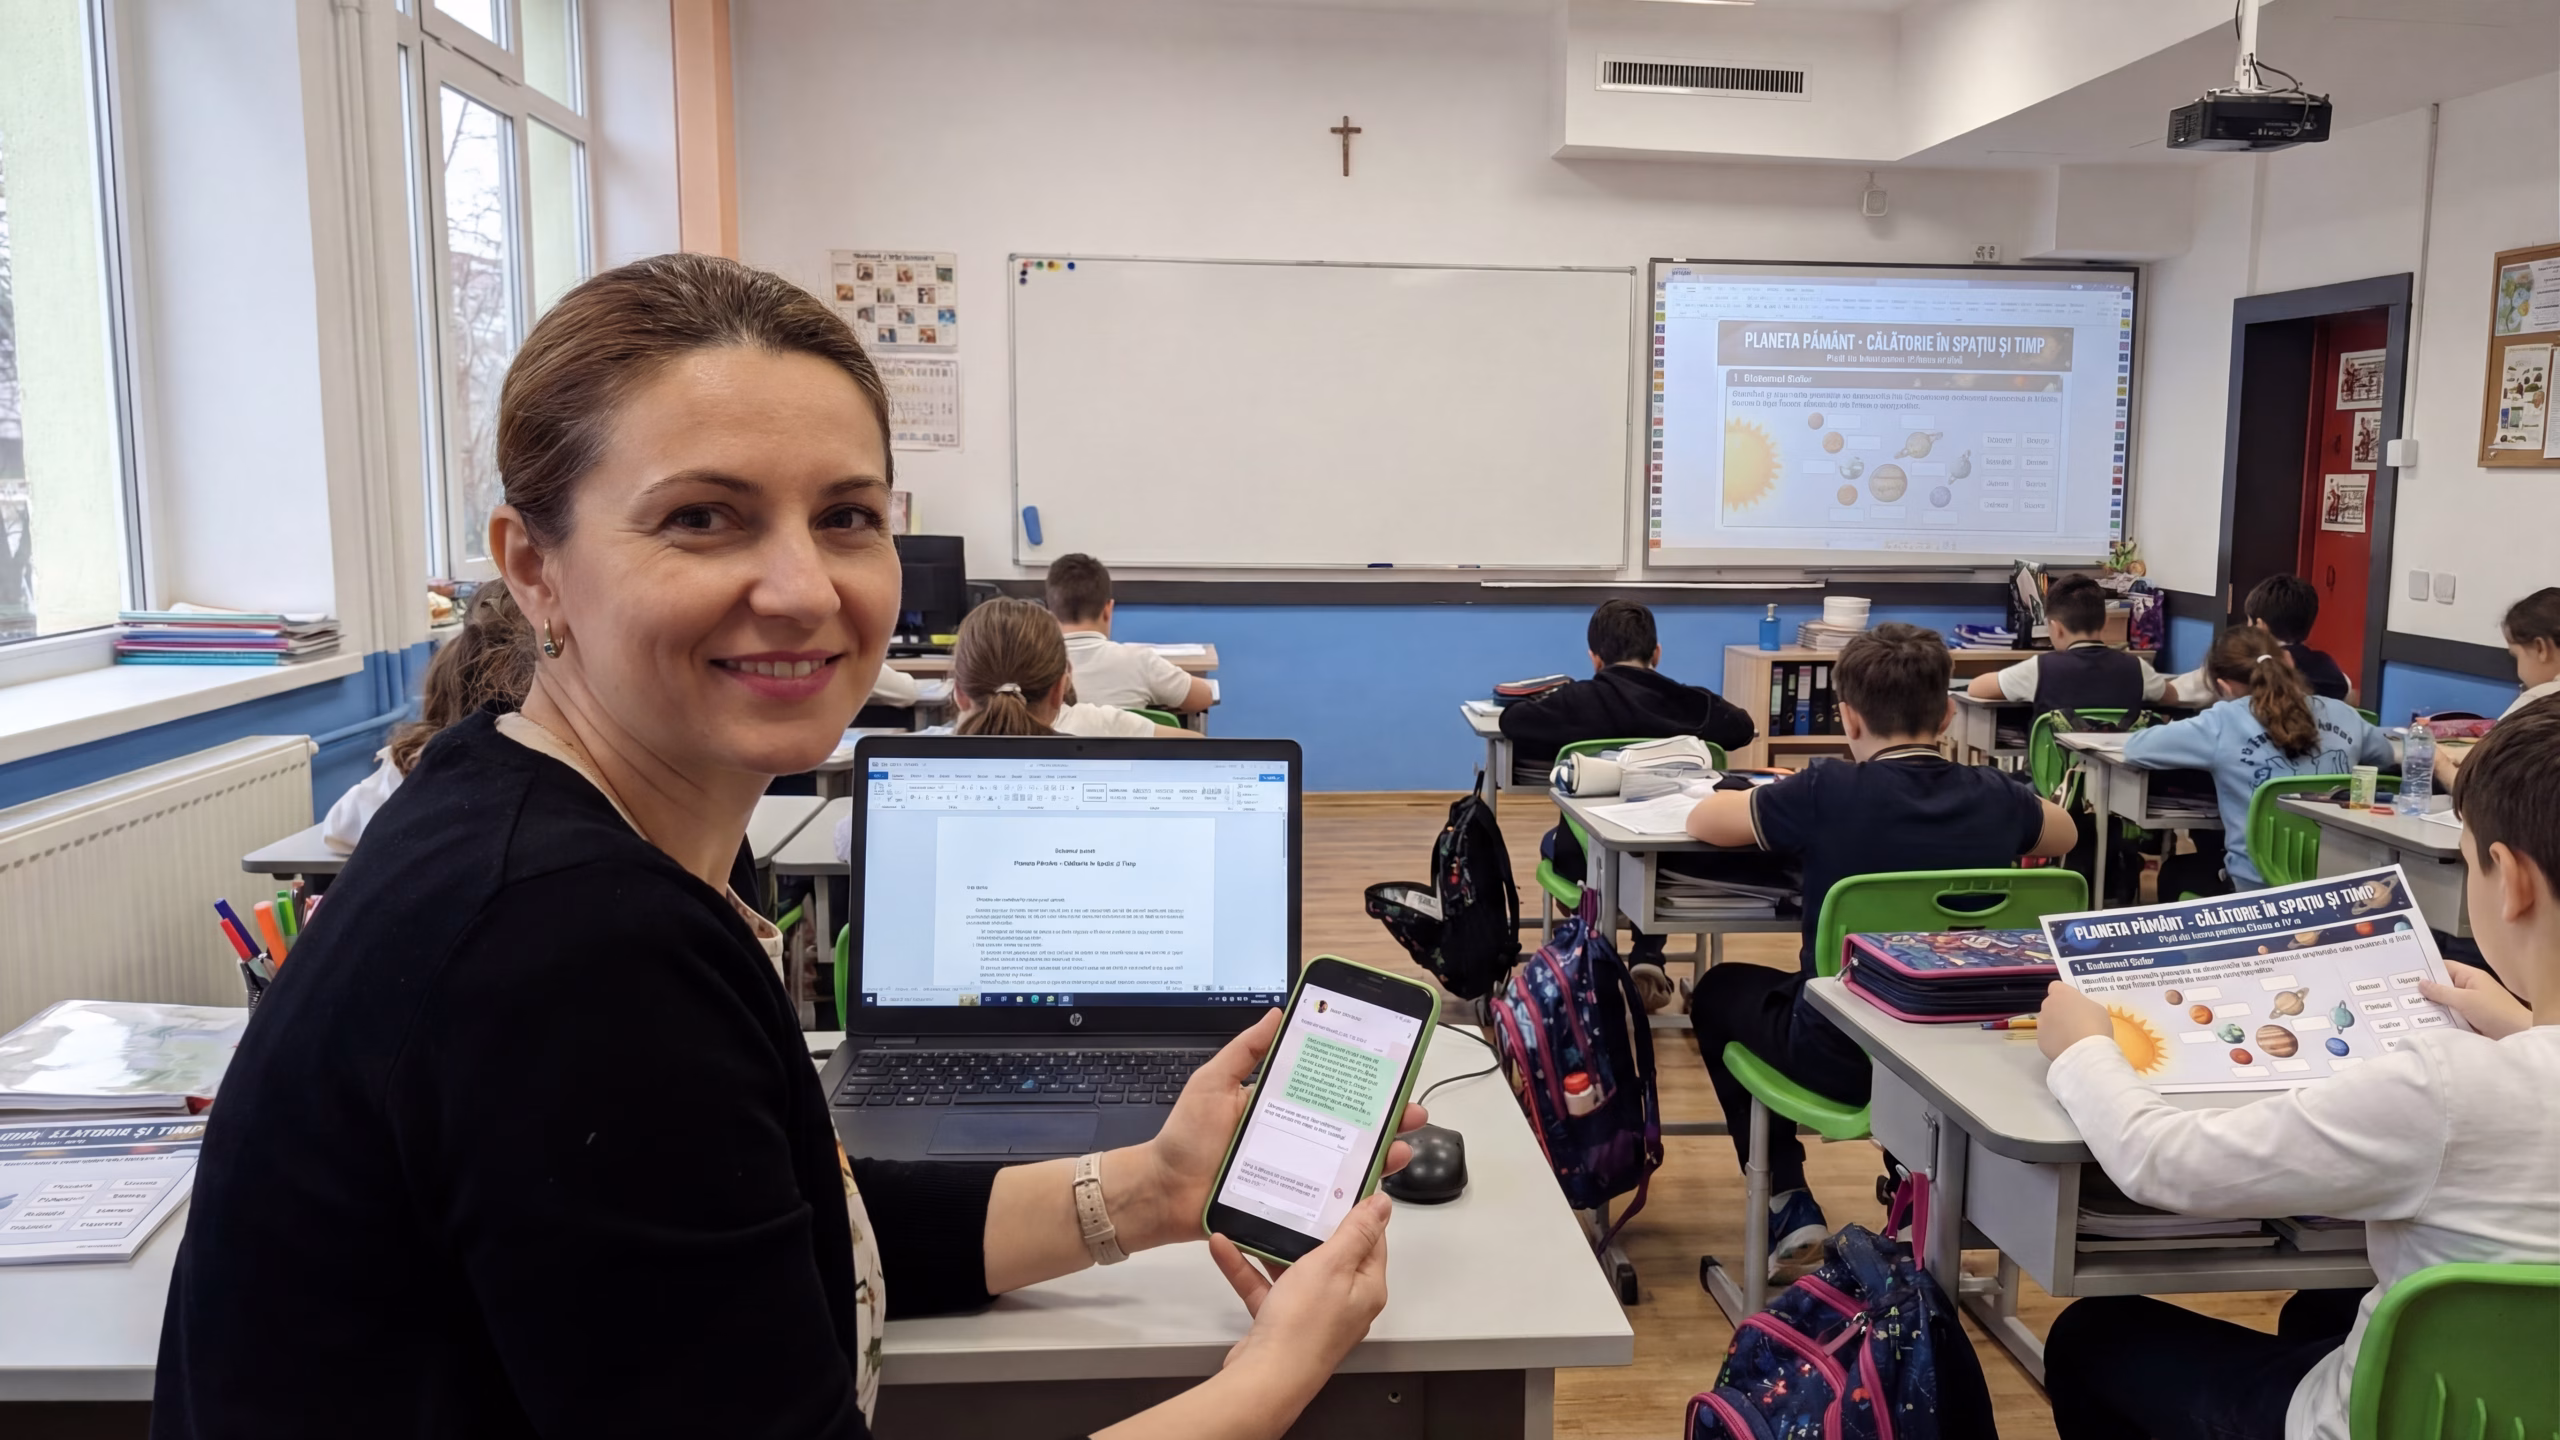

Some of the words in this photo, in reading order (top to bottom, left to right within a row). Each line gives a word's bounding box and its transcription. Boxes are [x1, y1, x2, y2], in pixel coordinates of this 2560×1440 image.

[1745, 331, 1800, 349] PLANETA
[2014, 337, 2045, 353] TIMP
[2074, 921, 2131, 941] PLANETA
